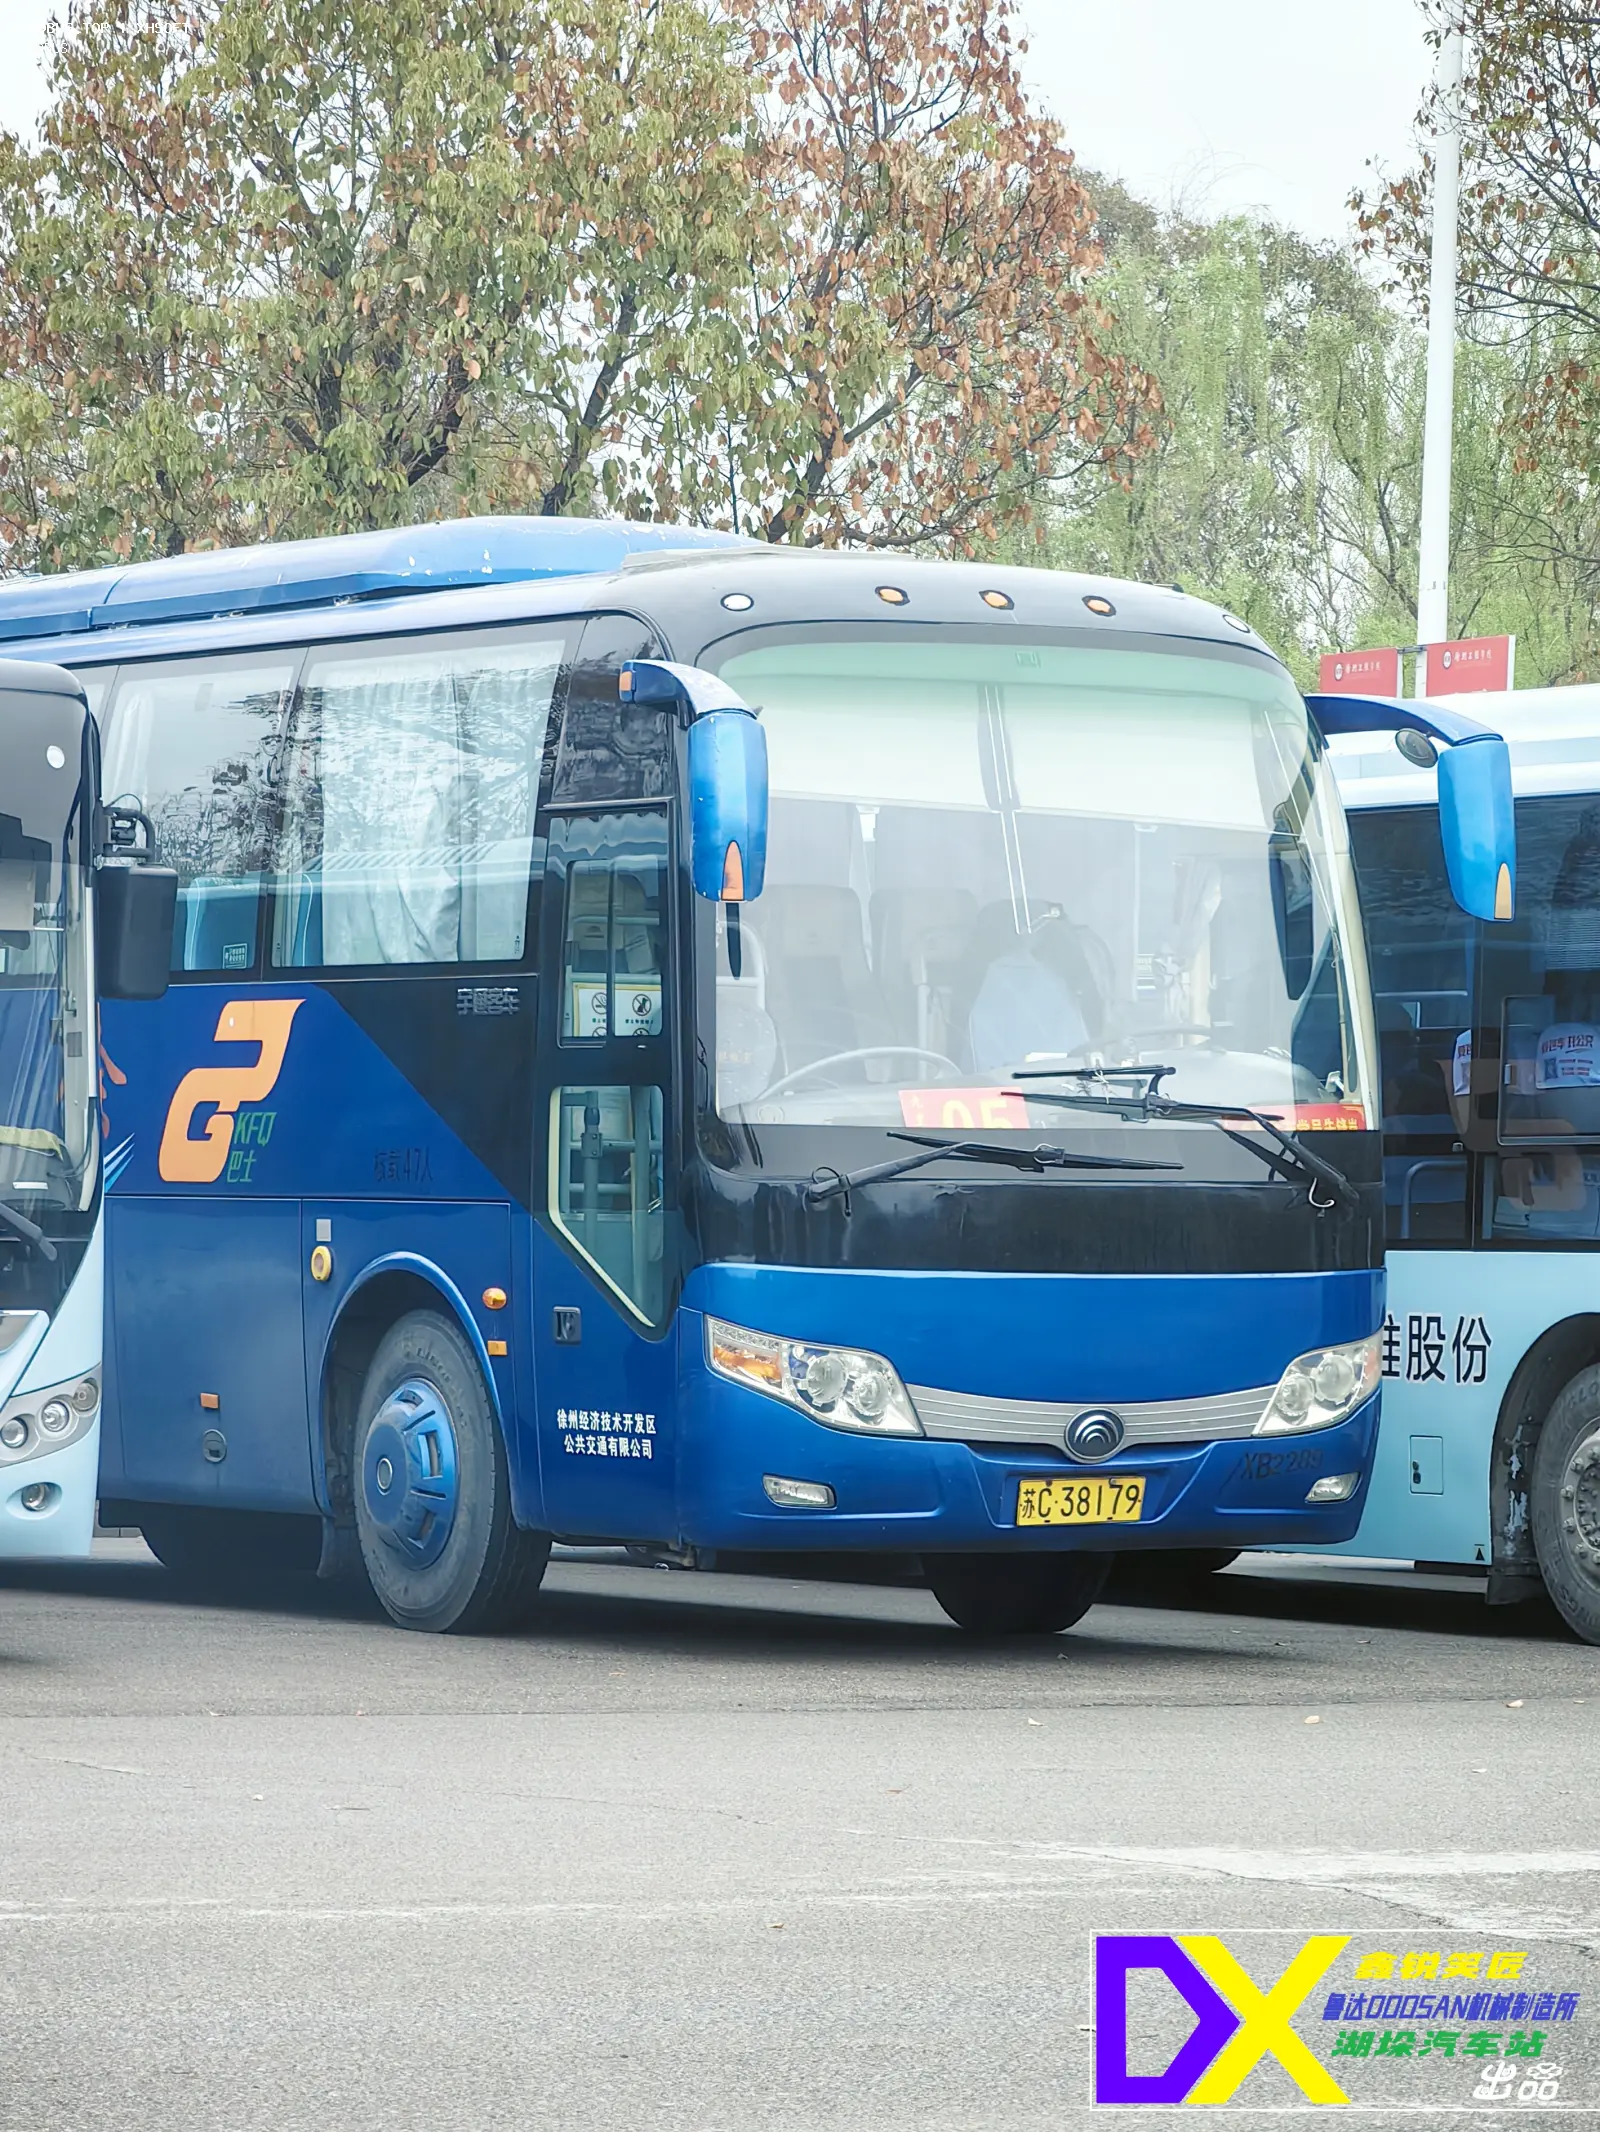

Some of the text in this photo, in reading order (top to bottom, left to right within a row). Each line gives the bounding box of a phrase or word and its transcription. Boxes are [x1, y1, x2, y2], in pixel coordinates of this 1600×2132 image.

[227, 1149, 257, 1182] 巴士
[557, 1408, 657, 1434] 徐州经济技术开发区
[564, 1433, 653, 1460] 公共交通有限公司
